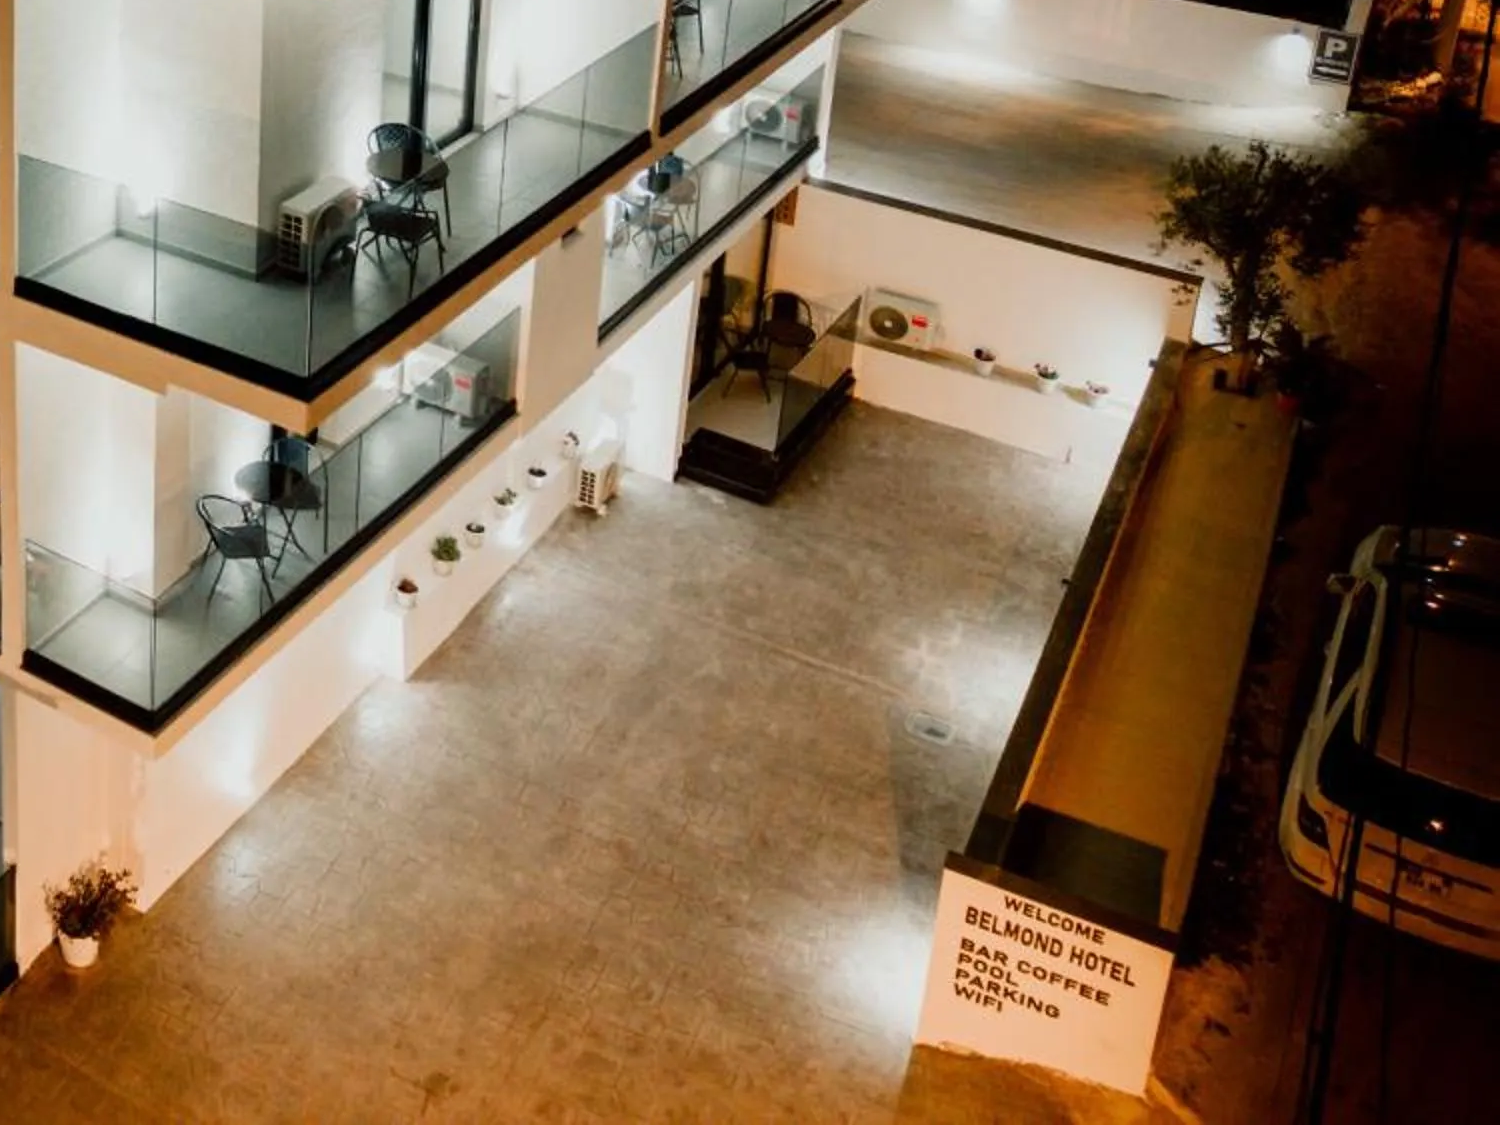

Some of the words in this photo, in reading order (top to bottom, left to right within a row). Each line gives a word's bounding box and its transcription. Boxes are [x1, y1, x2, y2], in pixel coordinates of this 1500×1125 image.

[1324, 37, 1348, 58] P
[1004, 895, 1106, 945] WELCOME
[958, 953, 1019, 987] POOL
[960, 937, 1008, 967] BAR
[1017, 960, 1111, 1006] COFFEE
[965, 906, 1063, 958] BELMOND
[1069, 946, 1136, 987] HOTEL
[953, 984, 1003, 1013] WIFI
[955, 968, 1060, 1019] PARKING
